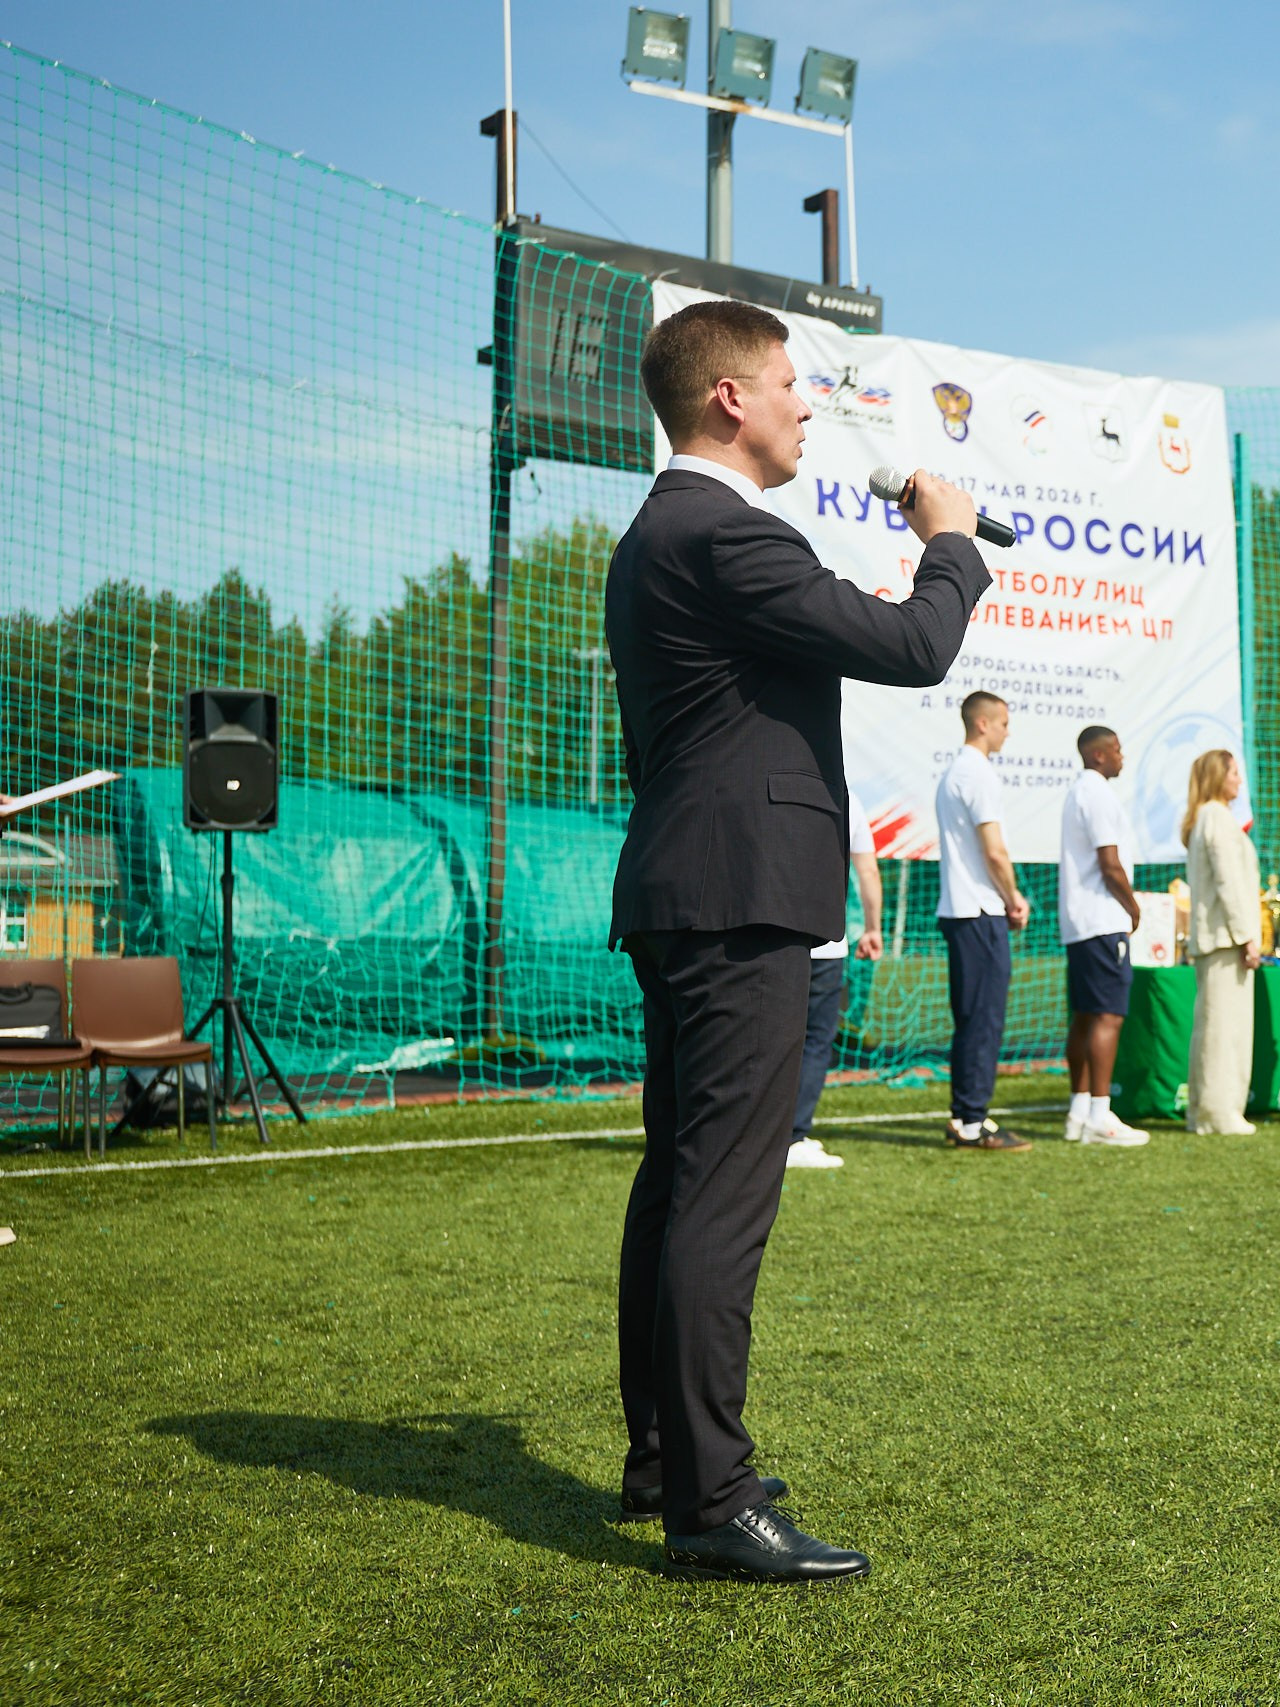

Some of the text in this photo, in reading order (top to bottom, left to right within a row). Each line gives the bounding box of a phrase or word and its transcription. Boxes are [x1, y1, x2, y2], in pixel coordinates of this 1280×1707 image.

[985, 481, 1026, 500] МАЯ
[1036, 486, 1082, 505] 2026
[816, 478, 1206, 567] КУБ РОССИИ
[988, 568, 1085, 599] ТБОЛУ
[1093, 580, 1145, 609] ЛИЦ
[1142, 617, 1174, 642] ЦП
[959, 655, 1049, 675] ОРОДСКАЯ
